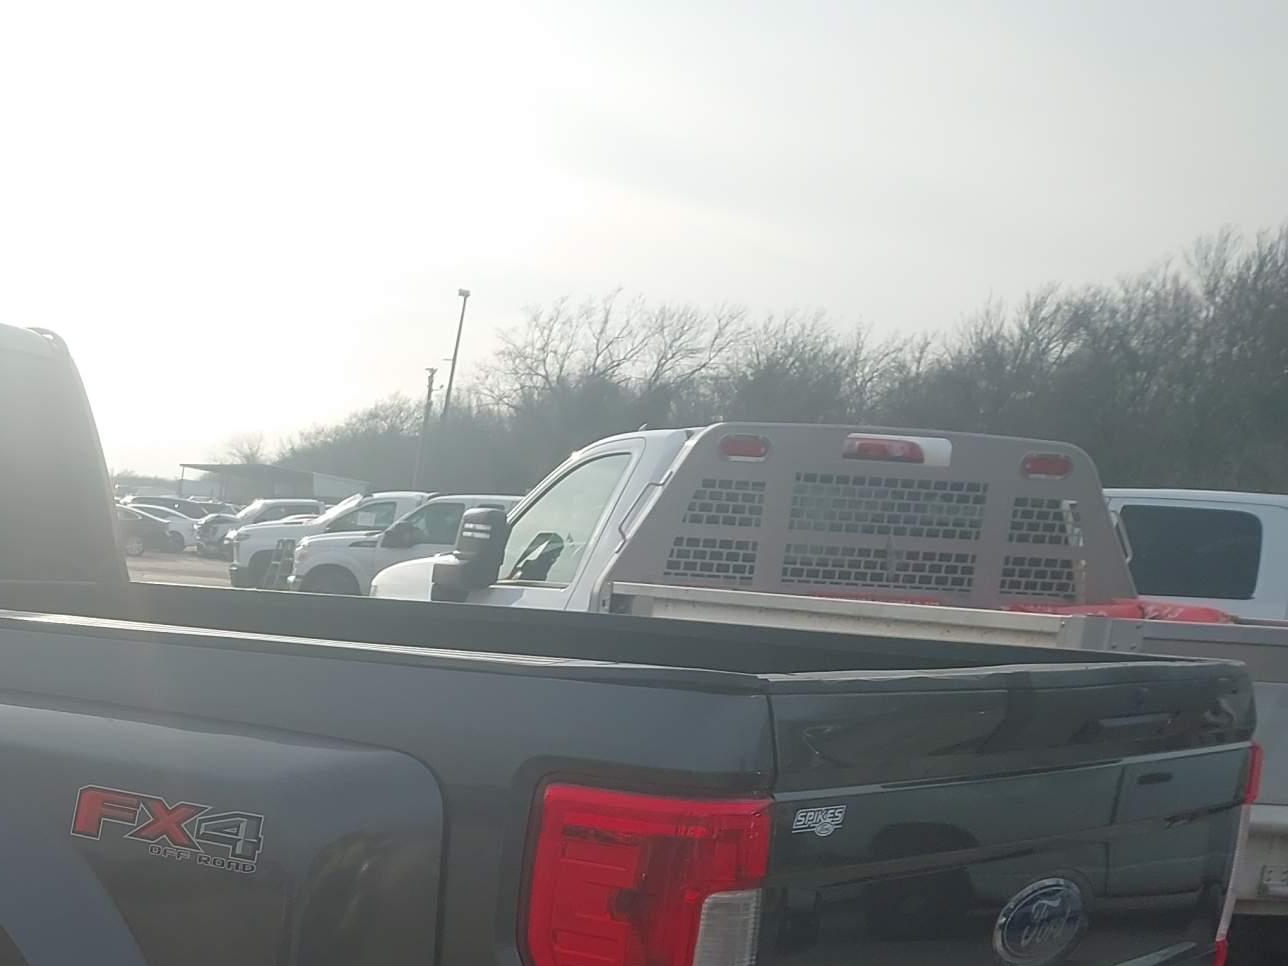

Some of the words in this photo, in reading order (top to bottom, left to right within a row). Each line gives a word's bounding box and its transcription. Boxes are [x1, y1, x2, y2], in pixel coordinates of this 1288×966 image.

[71, 785, 264, 863] FX4
[796, 809, 843, 825] SPIKES
[149, 845, 190, 860] OFF
[197, 853, 257, 874] ROAD
[1020, 897, 1070, 947] Ford
